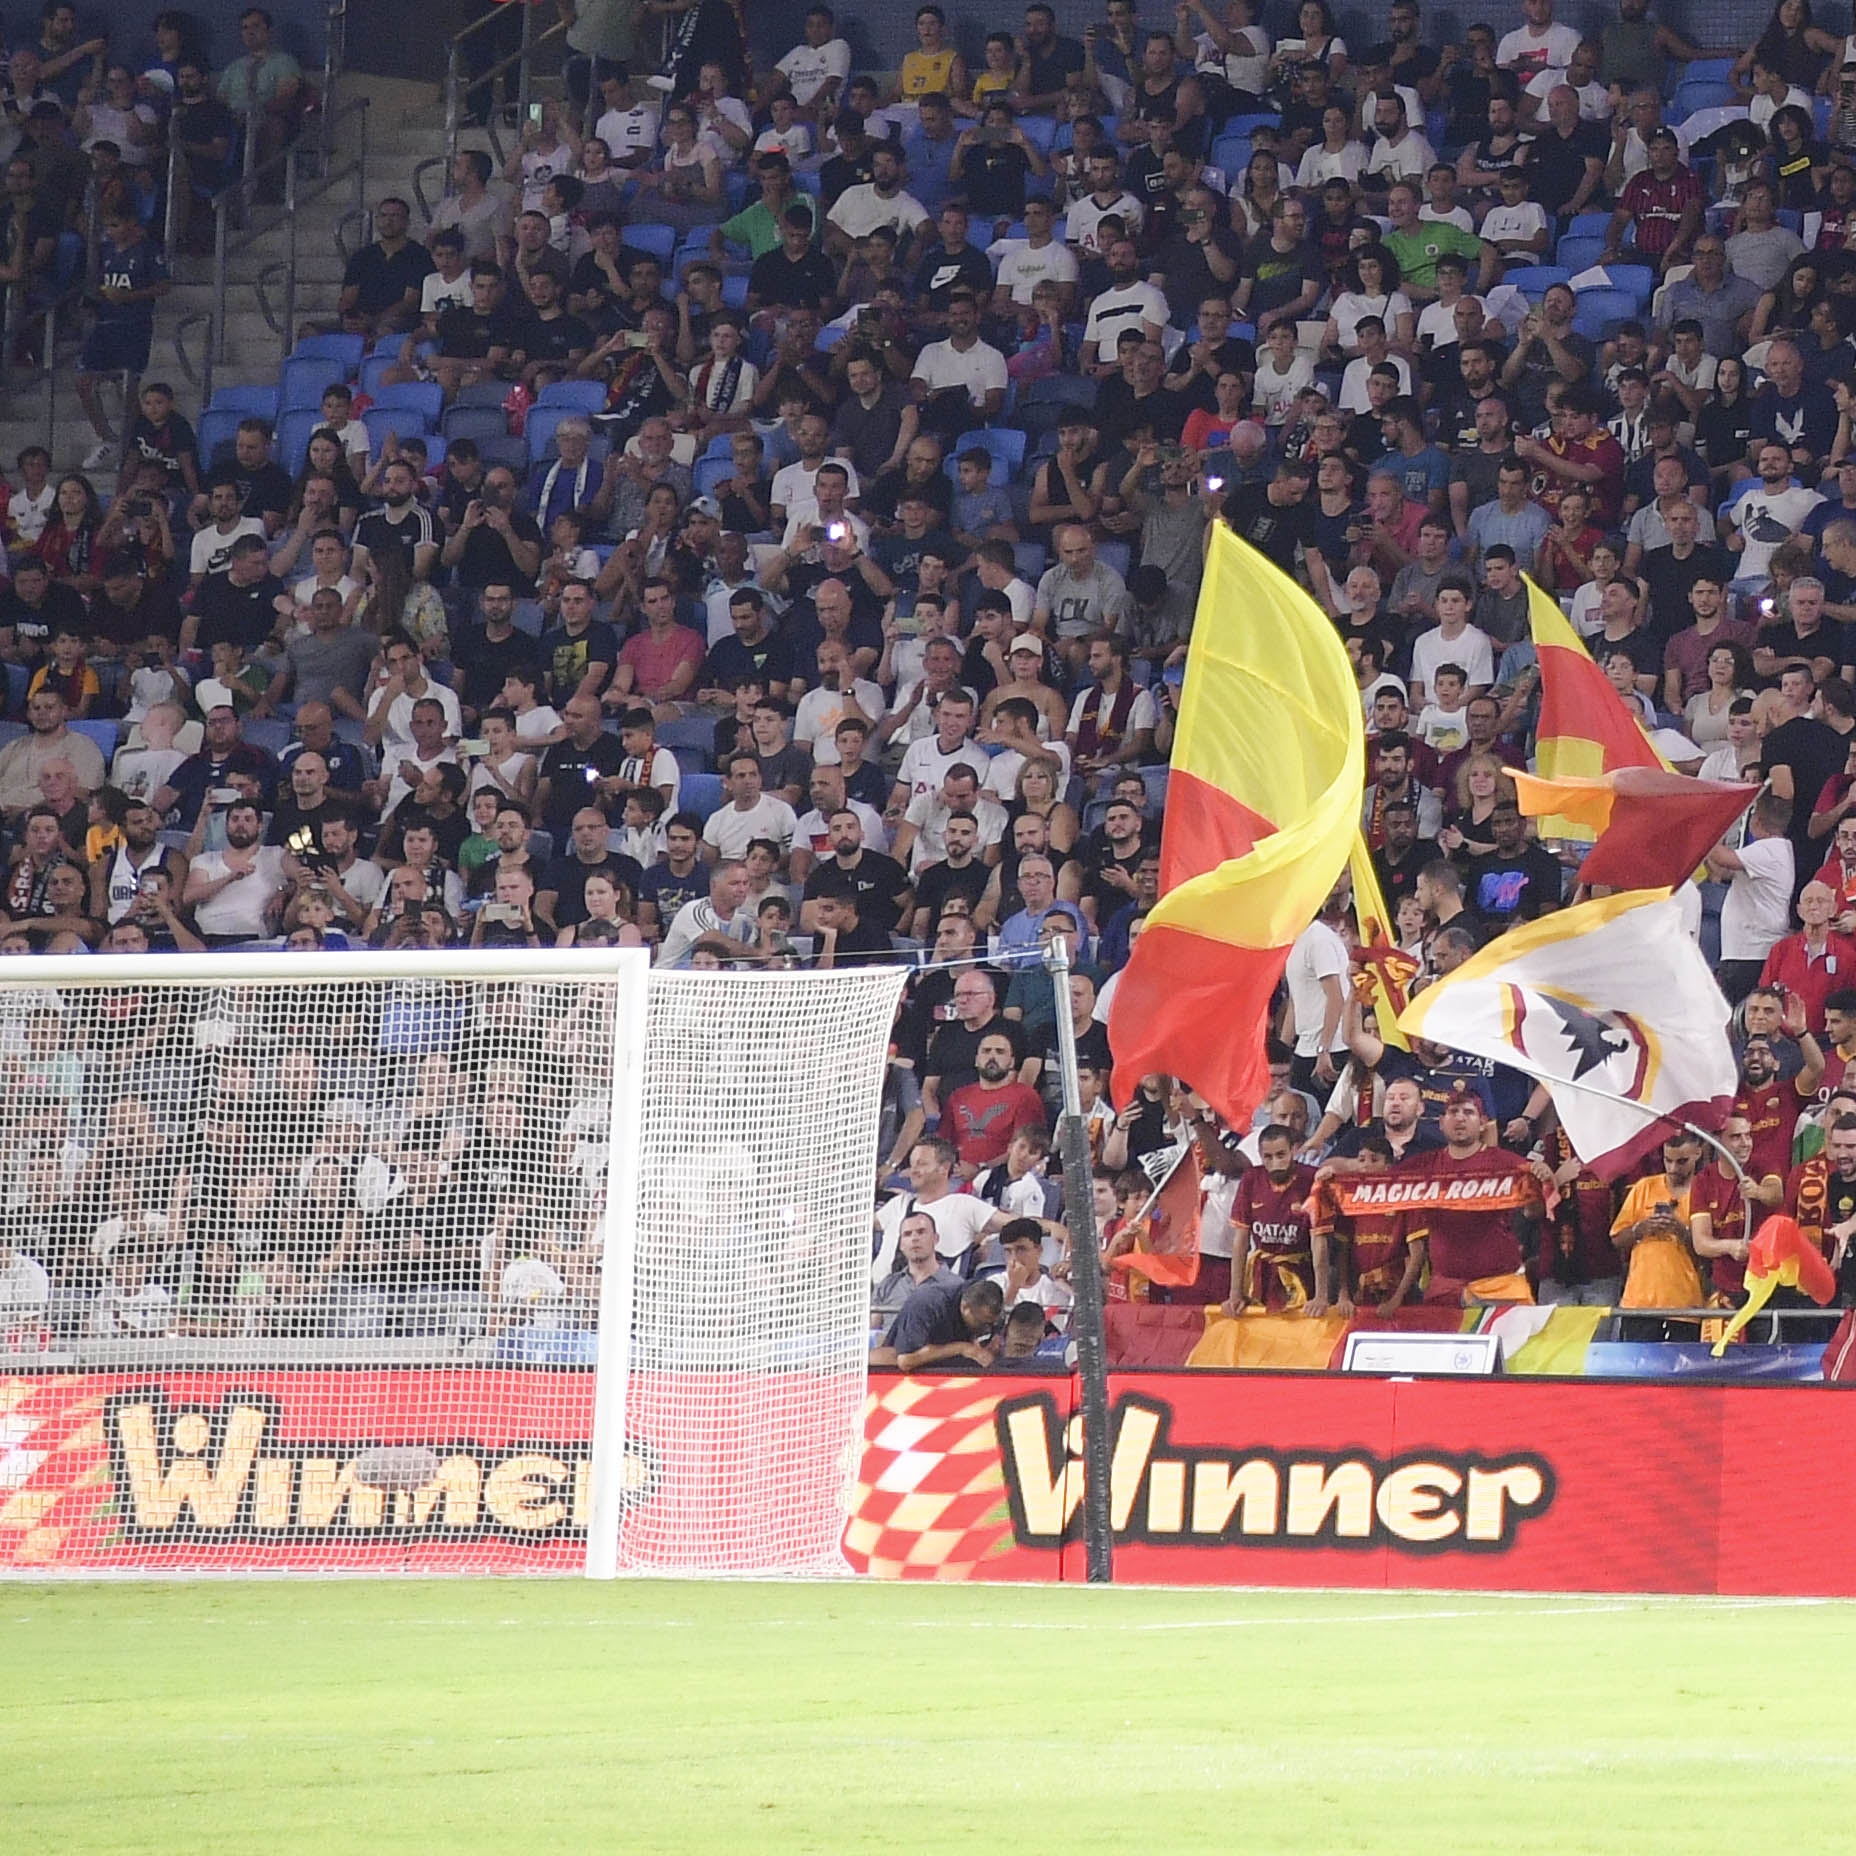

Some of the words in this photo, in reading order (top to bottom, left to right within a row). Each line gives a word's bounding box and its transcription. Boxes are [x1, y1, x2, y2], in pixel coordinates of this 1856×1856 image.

[1351, 1180, 1443, 1203] MAGICA
[1443, 1175, 1513, 1201] ROMA
[1252, 1222, 1298, 1240] QATAR
[1006, 1402, 1543, 1543] Winner
